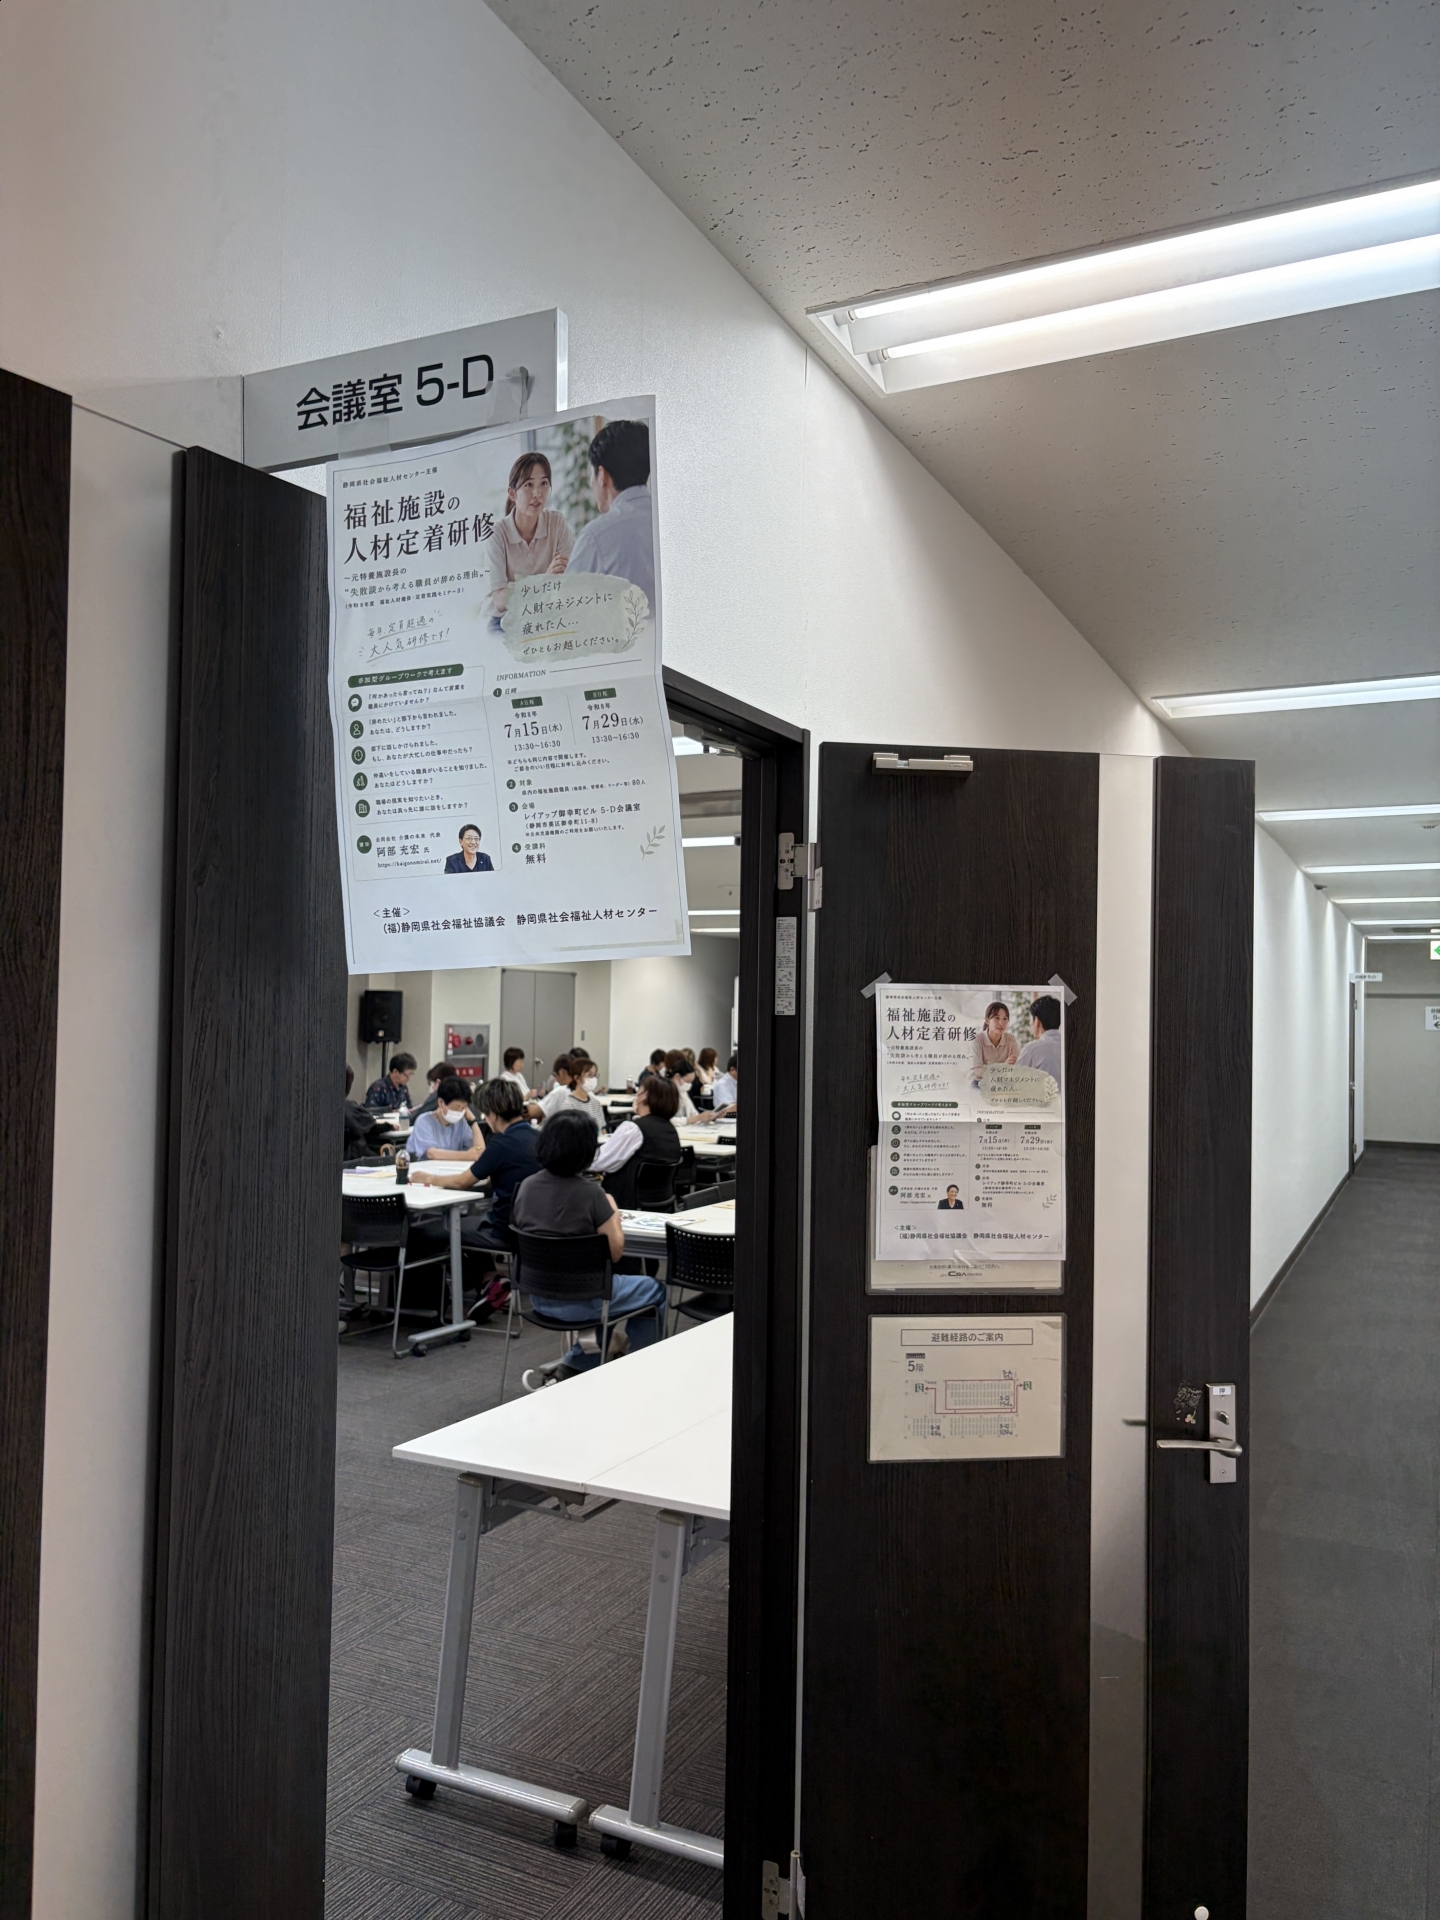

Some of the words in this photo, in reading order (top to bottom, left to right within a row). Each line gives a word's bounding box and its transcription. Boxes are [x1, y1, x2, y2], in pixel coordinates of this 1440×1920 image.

[296, 373, 404, 431] 会議室
[415, 354, 495, 408] 5-D
[342, 466, 438, 489] 静岡県社会福祉人材センター主催
[343, 489, 460, 530] 福祉施設の
[343, 512, 495, 564] 人材定着研修
[520, 580, 562, 597] 少しだけ
[521, 592, 613, 616] 人財マネジメントに
[369, 627, 451, 658] 大人気研修です!
[522, 636, 620, 656] ぜひともお越しください。
[358, 667, 453, 684] 参加型グループワークで考えます
[496, 669, 547, 681] INFORMATION
[504, 687, 517, 695] 日時
[514, 710, 538, 719] 令和8年
[587, 702, 611, 711] 令和8年
[369, 723, 431, 736] あなたは、どうしますか?
[504, 721, 563, 738] 7月15日(水)
[582, 712, 644, 730] 7月29日(水)
[591, 731, 640, 743] 13:30～16:30
[371, 740, 438, 752] 部下に話しかけられました。
[374, 777, 434, 789] あなたはどうしますか?
[518, 779, 533, 787] 対象
[521, 802, 535, 810] 会場
[524, 807, 598, 820] レイアップ御幸町ビル
[600, 803, 641, 814] 5-D会議室
[376, 845, 397, 858] 阿部
[423, 846, 430, 854] 氏
[525, 852, 547, 865] 無料
[383, 915, 506, 934] (福)静岡県社会福祉協議会
[516, 907, 658, 926] 静岡県社会福祉人材センター
[886, 1007, 956, 1023] 福祉施設の
[886, 1026, 977, 1042] 人材定着研修
[973, 1232, 1050, 1240] 静岡県社会福祉人材センター
[931, 1332, 1004, 1343] 避難経路のご案内
[907, 1360, 925, 1373] 5階
